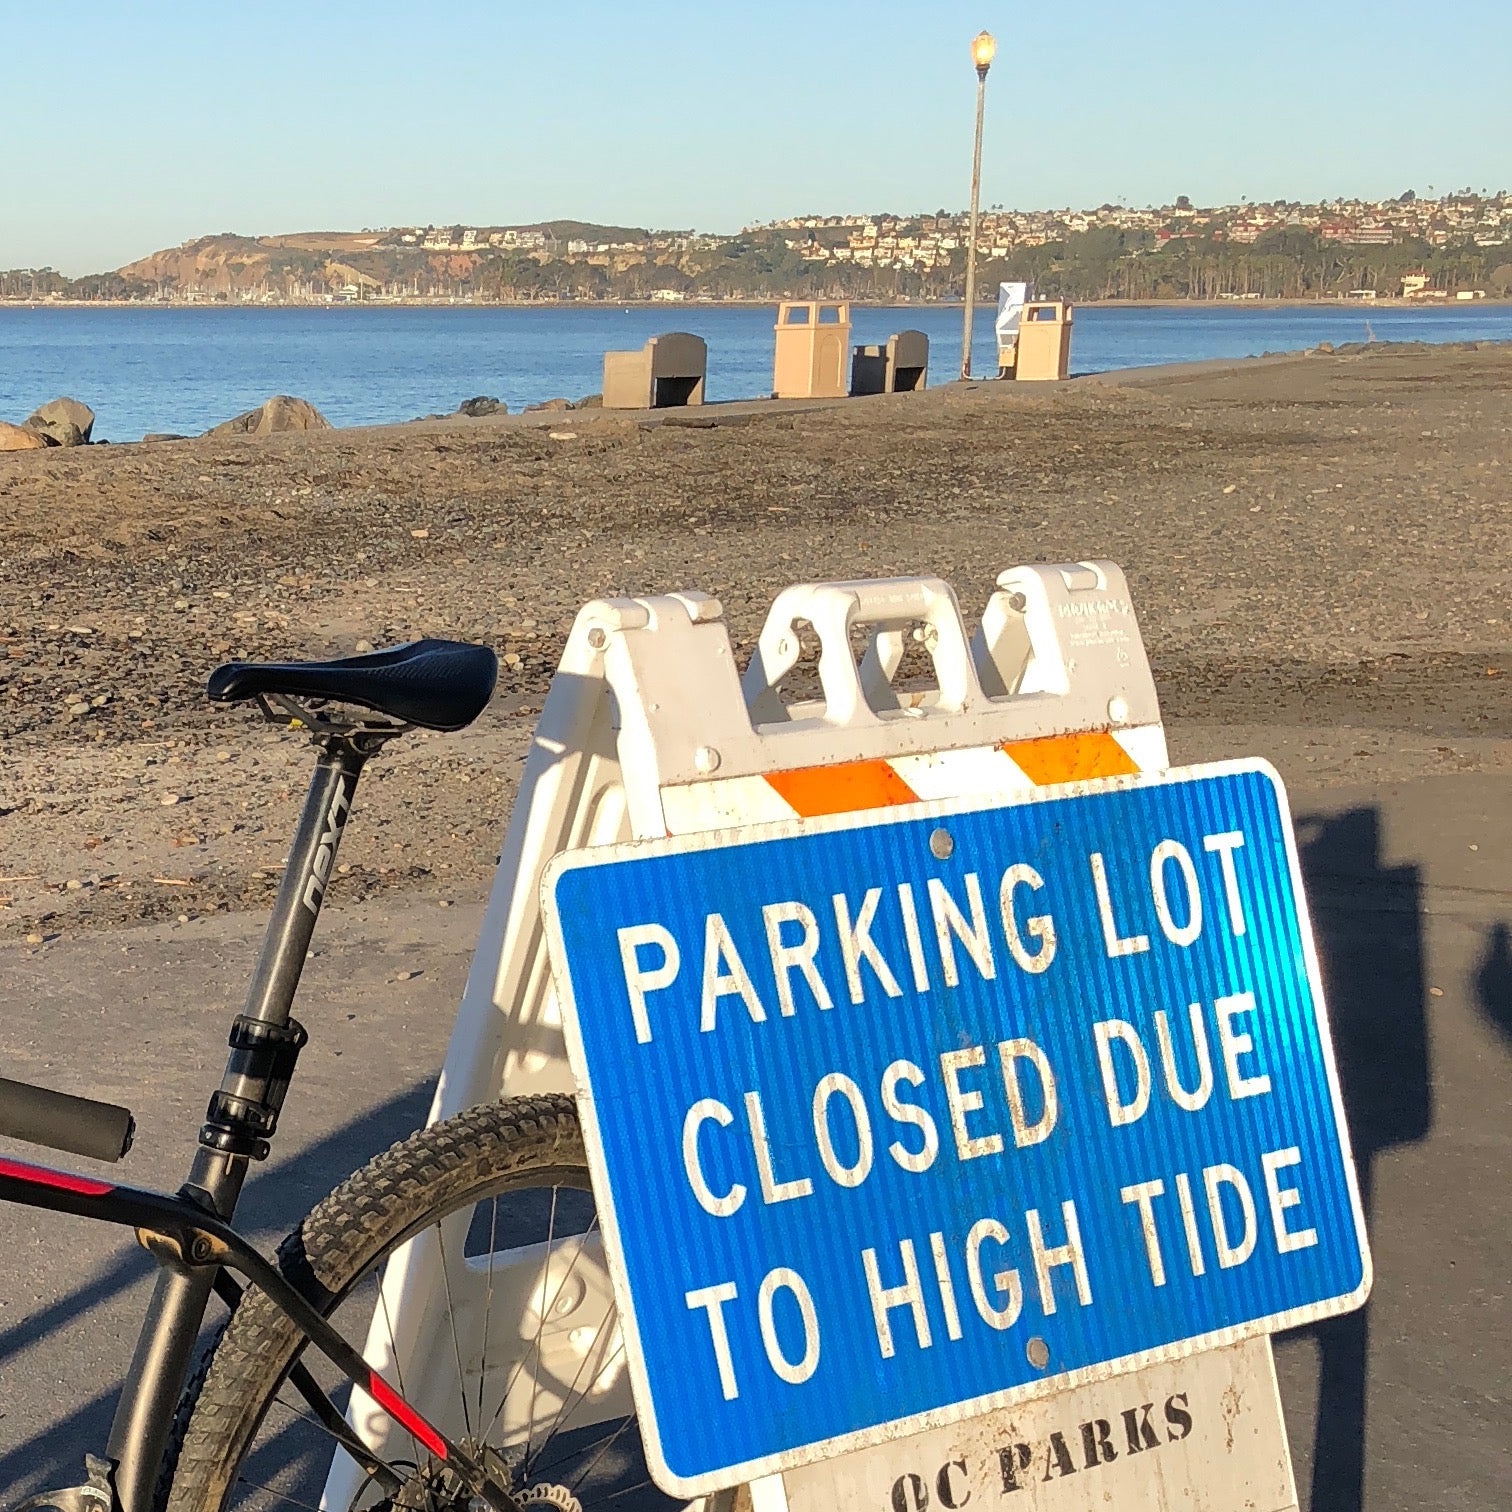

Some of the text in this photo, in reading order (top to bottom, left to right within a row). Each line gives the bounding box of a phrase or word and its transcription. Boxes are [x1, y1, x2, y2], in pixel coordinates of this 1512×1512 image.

[617, 830, 1245, 1044] PARKING LOT
[682, 991, 1271, 1217] CLOSED DUE
[685, 1146, 1318, 1402] TO HIGH TIDE
[995, 1392, 1193, 1495] PARKS
